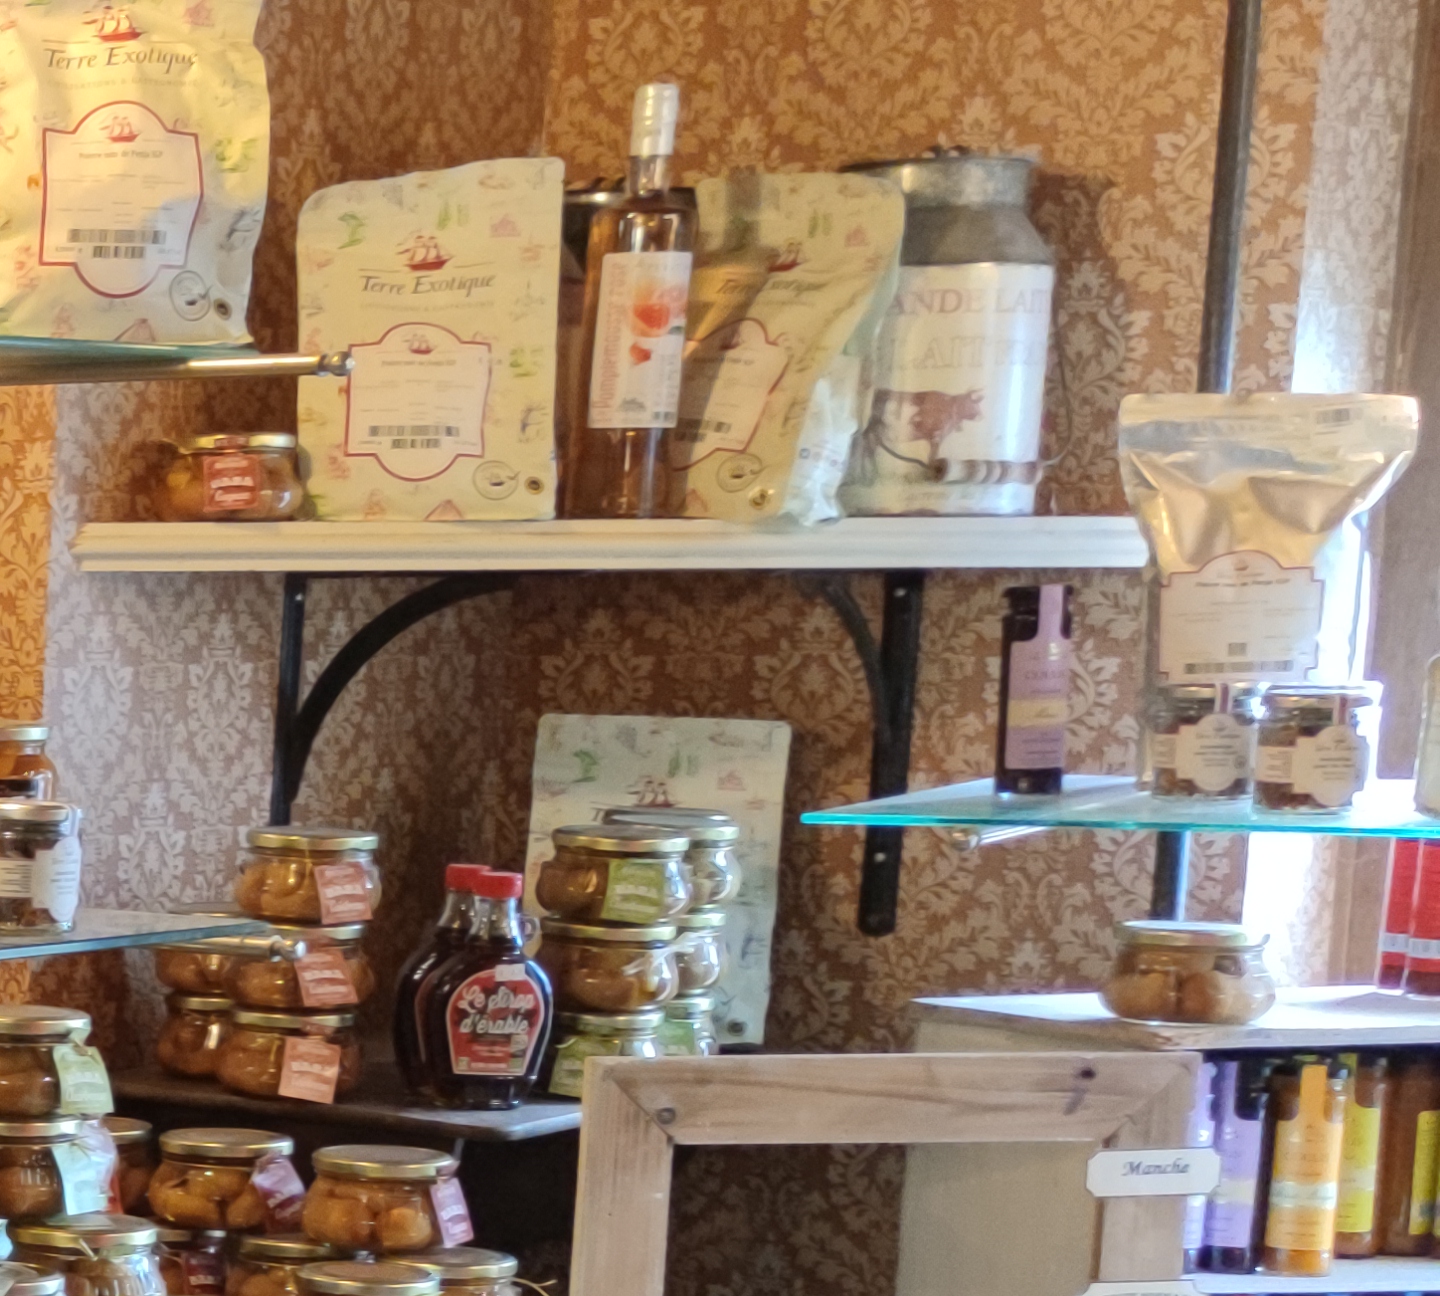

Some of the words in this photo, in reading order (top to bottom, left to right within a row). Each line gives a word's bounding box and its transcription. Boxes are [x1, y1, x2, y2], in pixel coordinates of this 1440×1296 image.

[43, 47, 98, 71] Terre
[106, 46, 198, 75] Exotique
[360, 275, 406, 295] Terre
[411, 275, 497, 297] Exotique
[458, 986, 485, 1013] Le
[460, 1014, 529, 1036] d'érable
[1122, 1158, 1191, 1178] Manche
